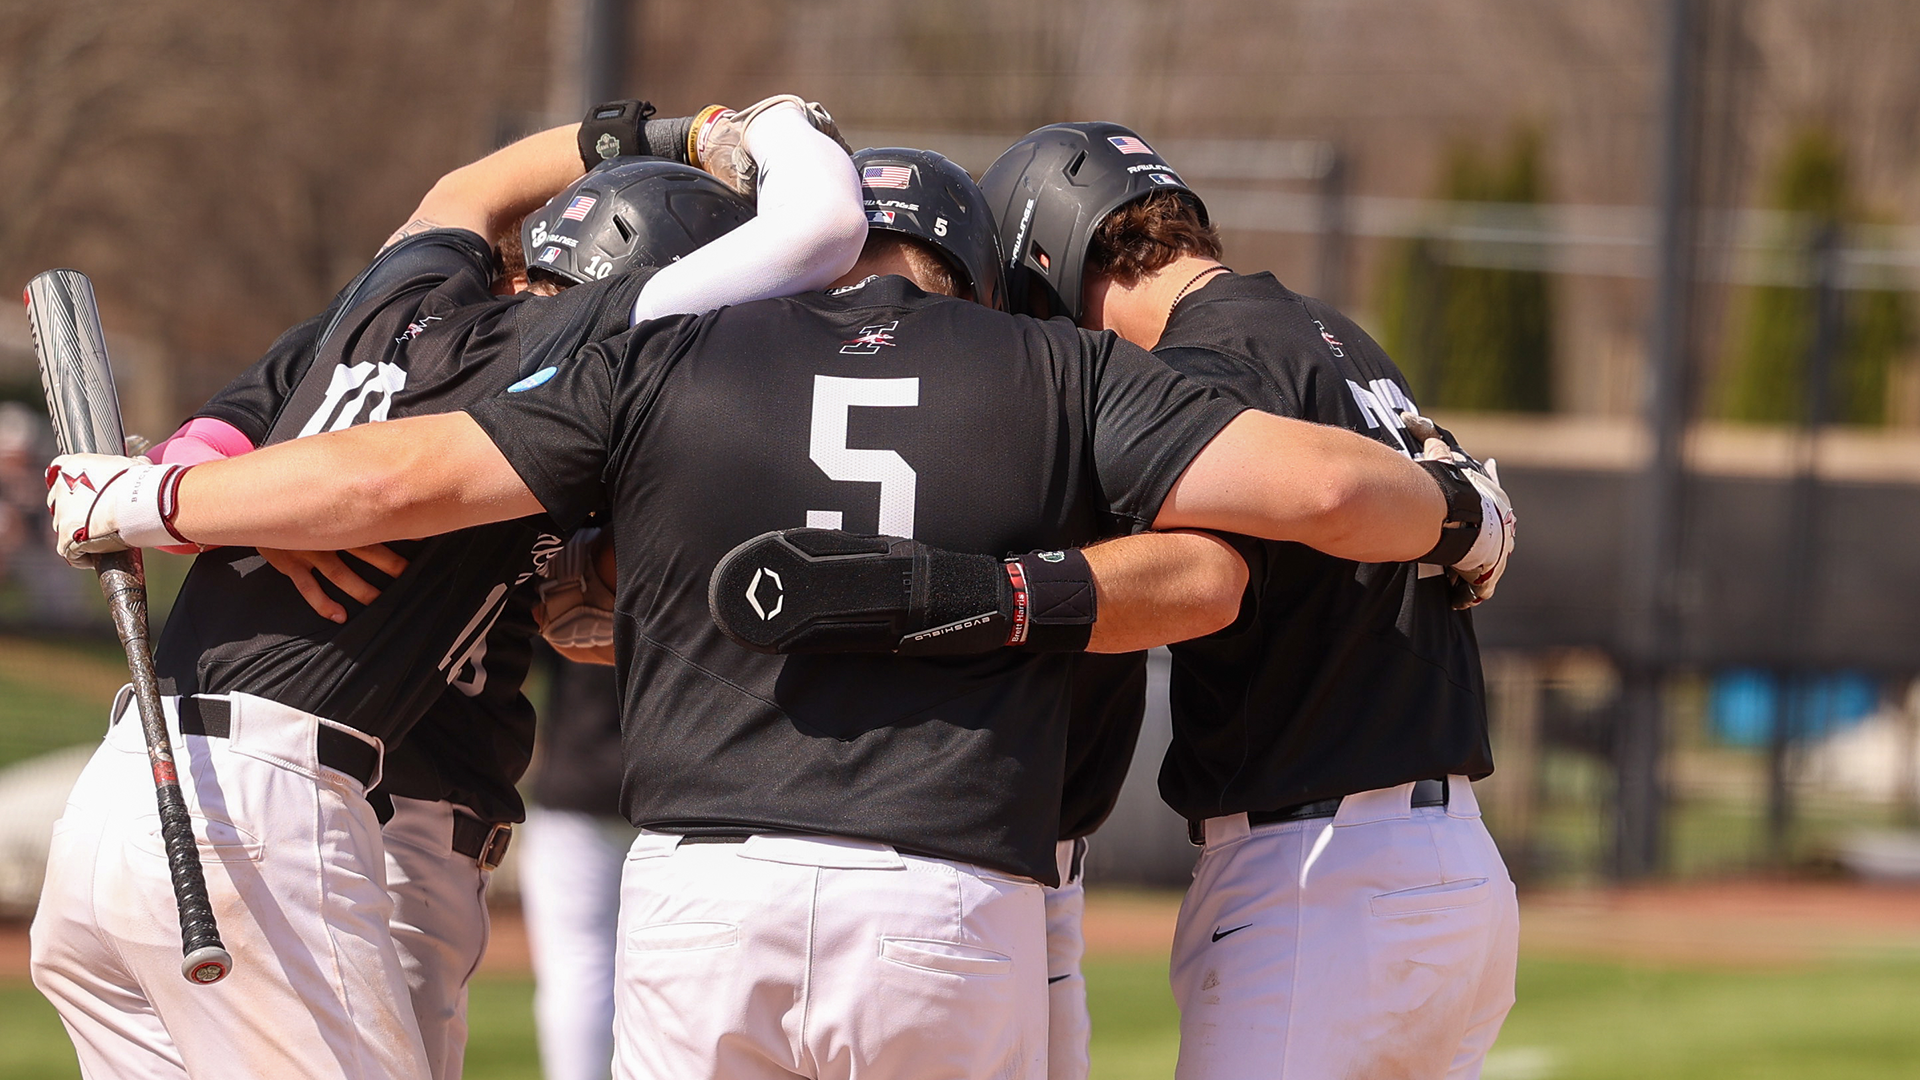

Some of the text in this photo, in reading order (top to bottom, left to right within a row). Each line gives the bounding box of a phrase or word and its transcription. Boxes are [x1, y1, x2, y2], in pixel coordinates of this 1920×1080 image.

[933, 216, 949, 237] 5
[1010, 199, 1034, 269] RAWLINGS
[584, 255, 614, 281] 10
[806, 374, 920, 541] 5
[914, 616, 991, 641] EVOSHIELD
[1011, 593, 1025, 642] Brett Harris
